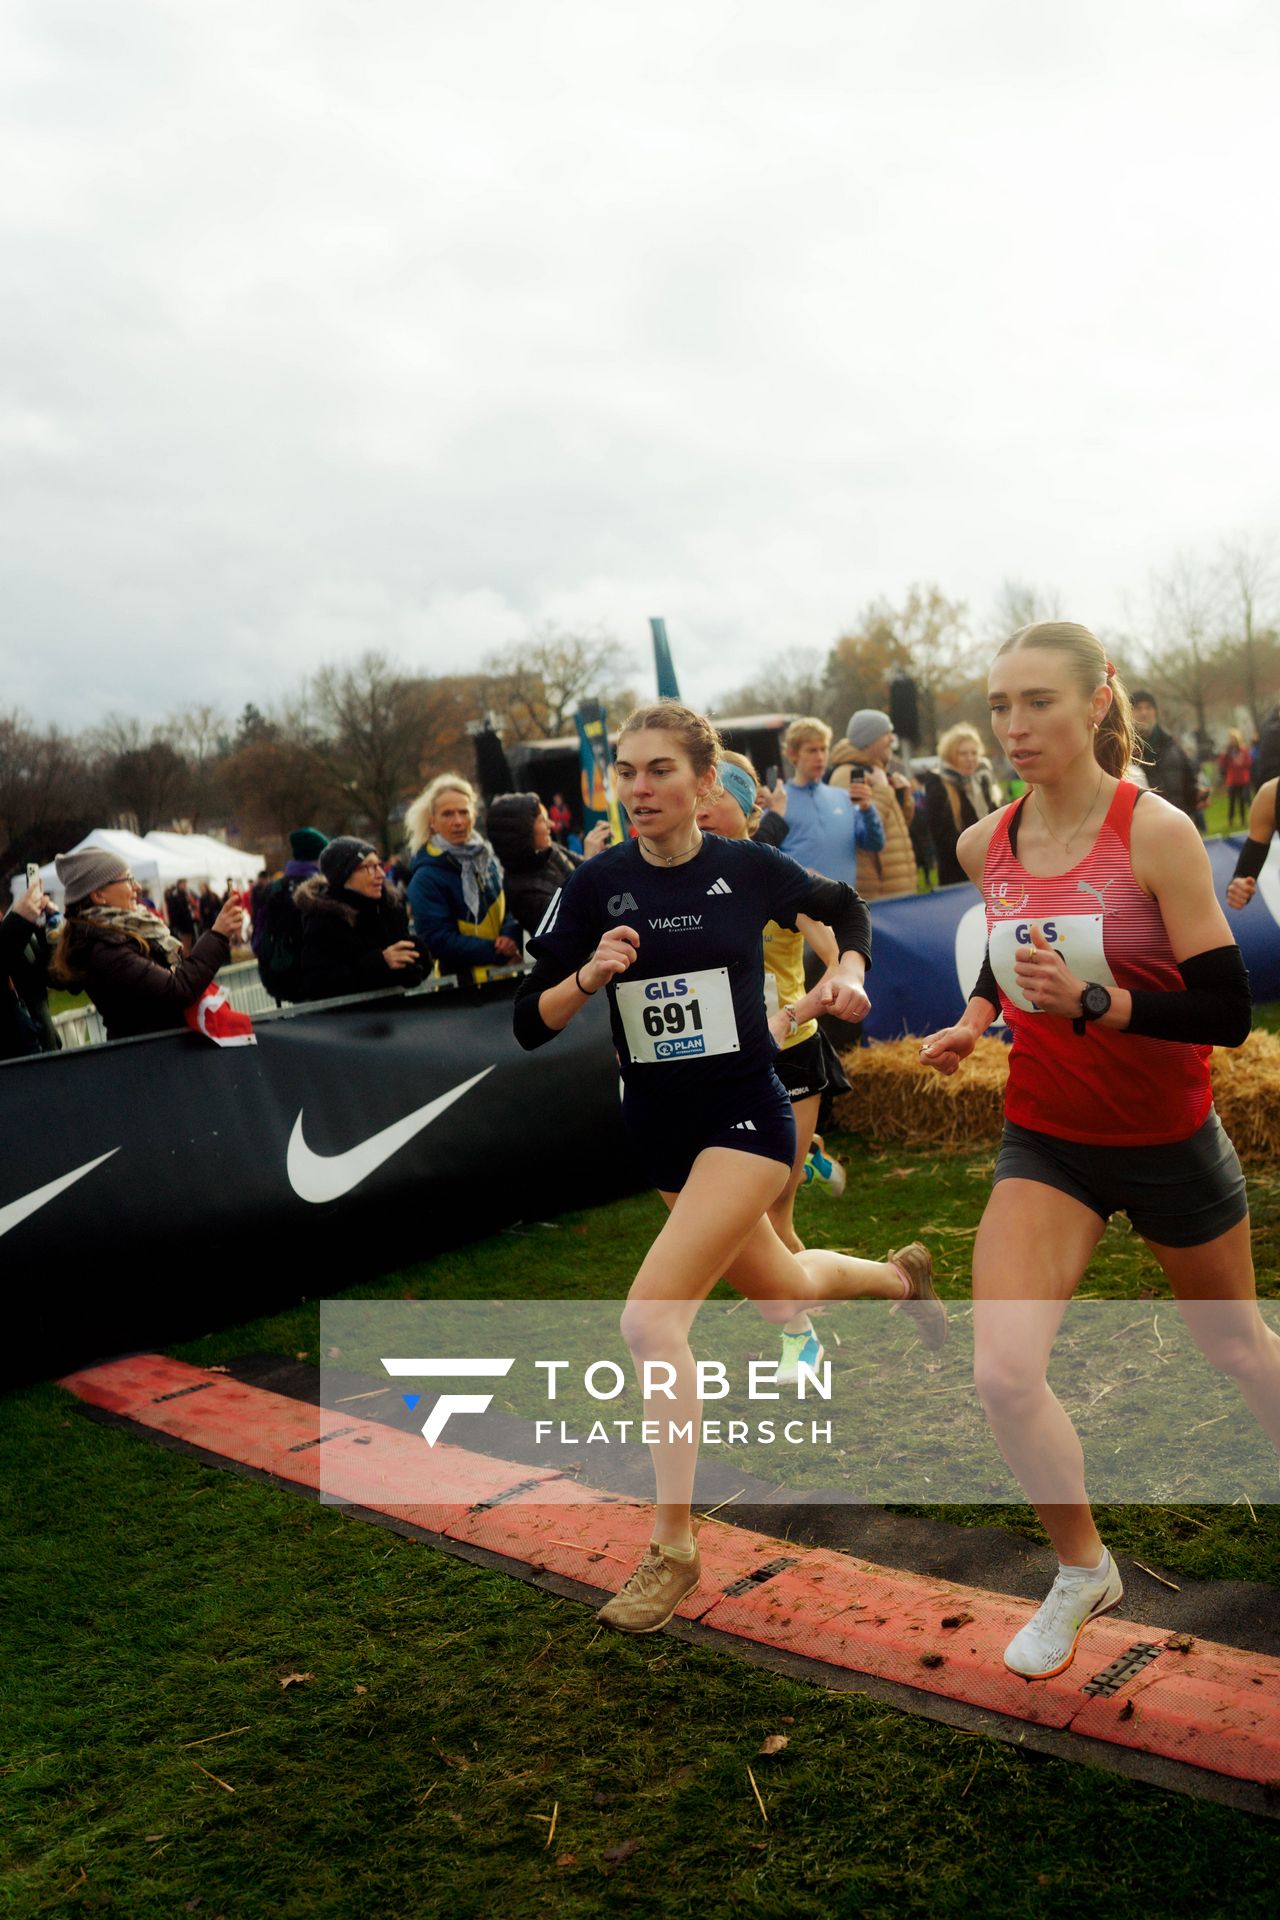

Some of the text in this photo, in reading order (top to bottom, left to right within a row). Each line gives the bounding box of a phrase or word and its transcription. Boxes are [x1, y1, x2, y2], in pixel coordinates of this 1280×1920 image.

[648, 914, 702, 930] VIACTIV
[643, 999, 703, 1037] 691
[674, 1039, 702, 1051] PLAN
[788, 1086, 810, 1097] HOKA
